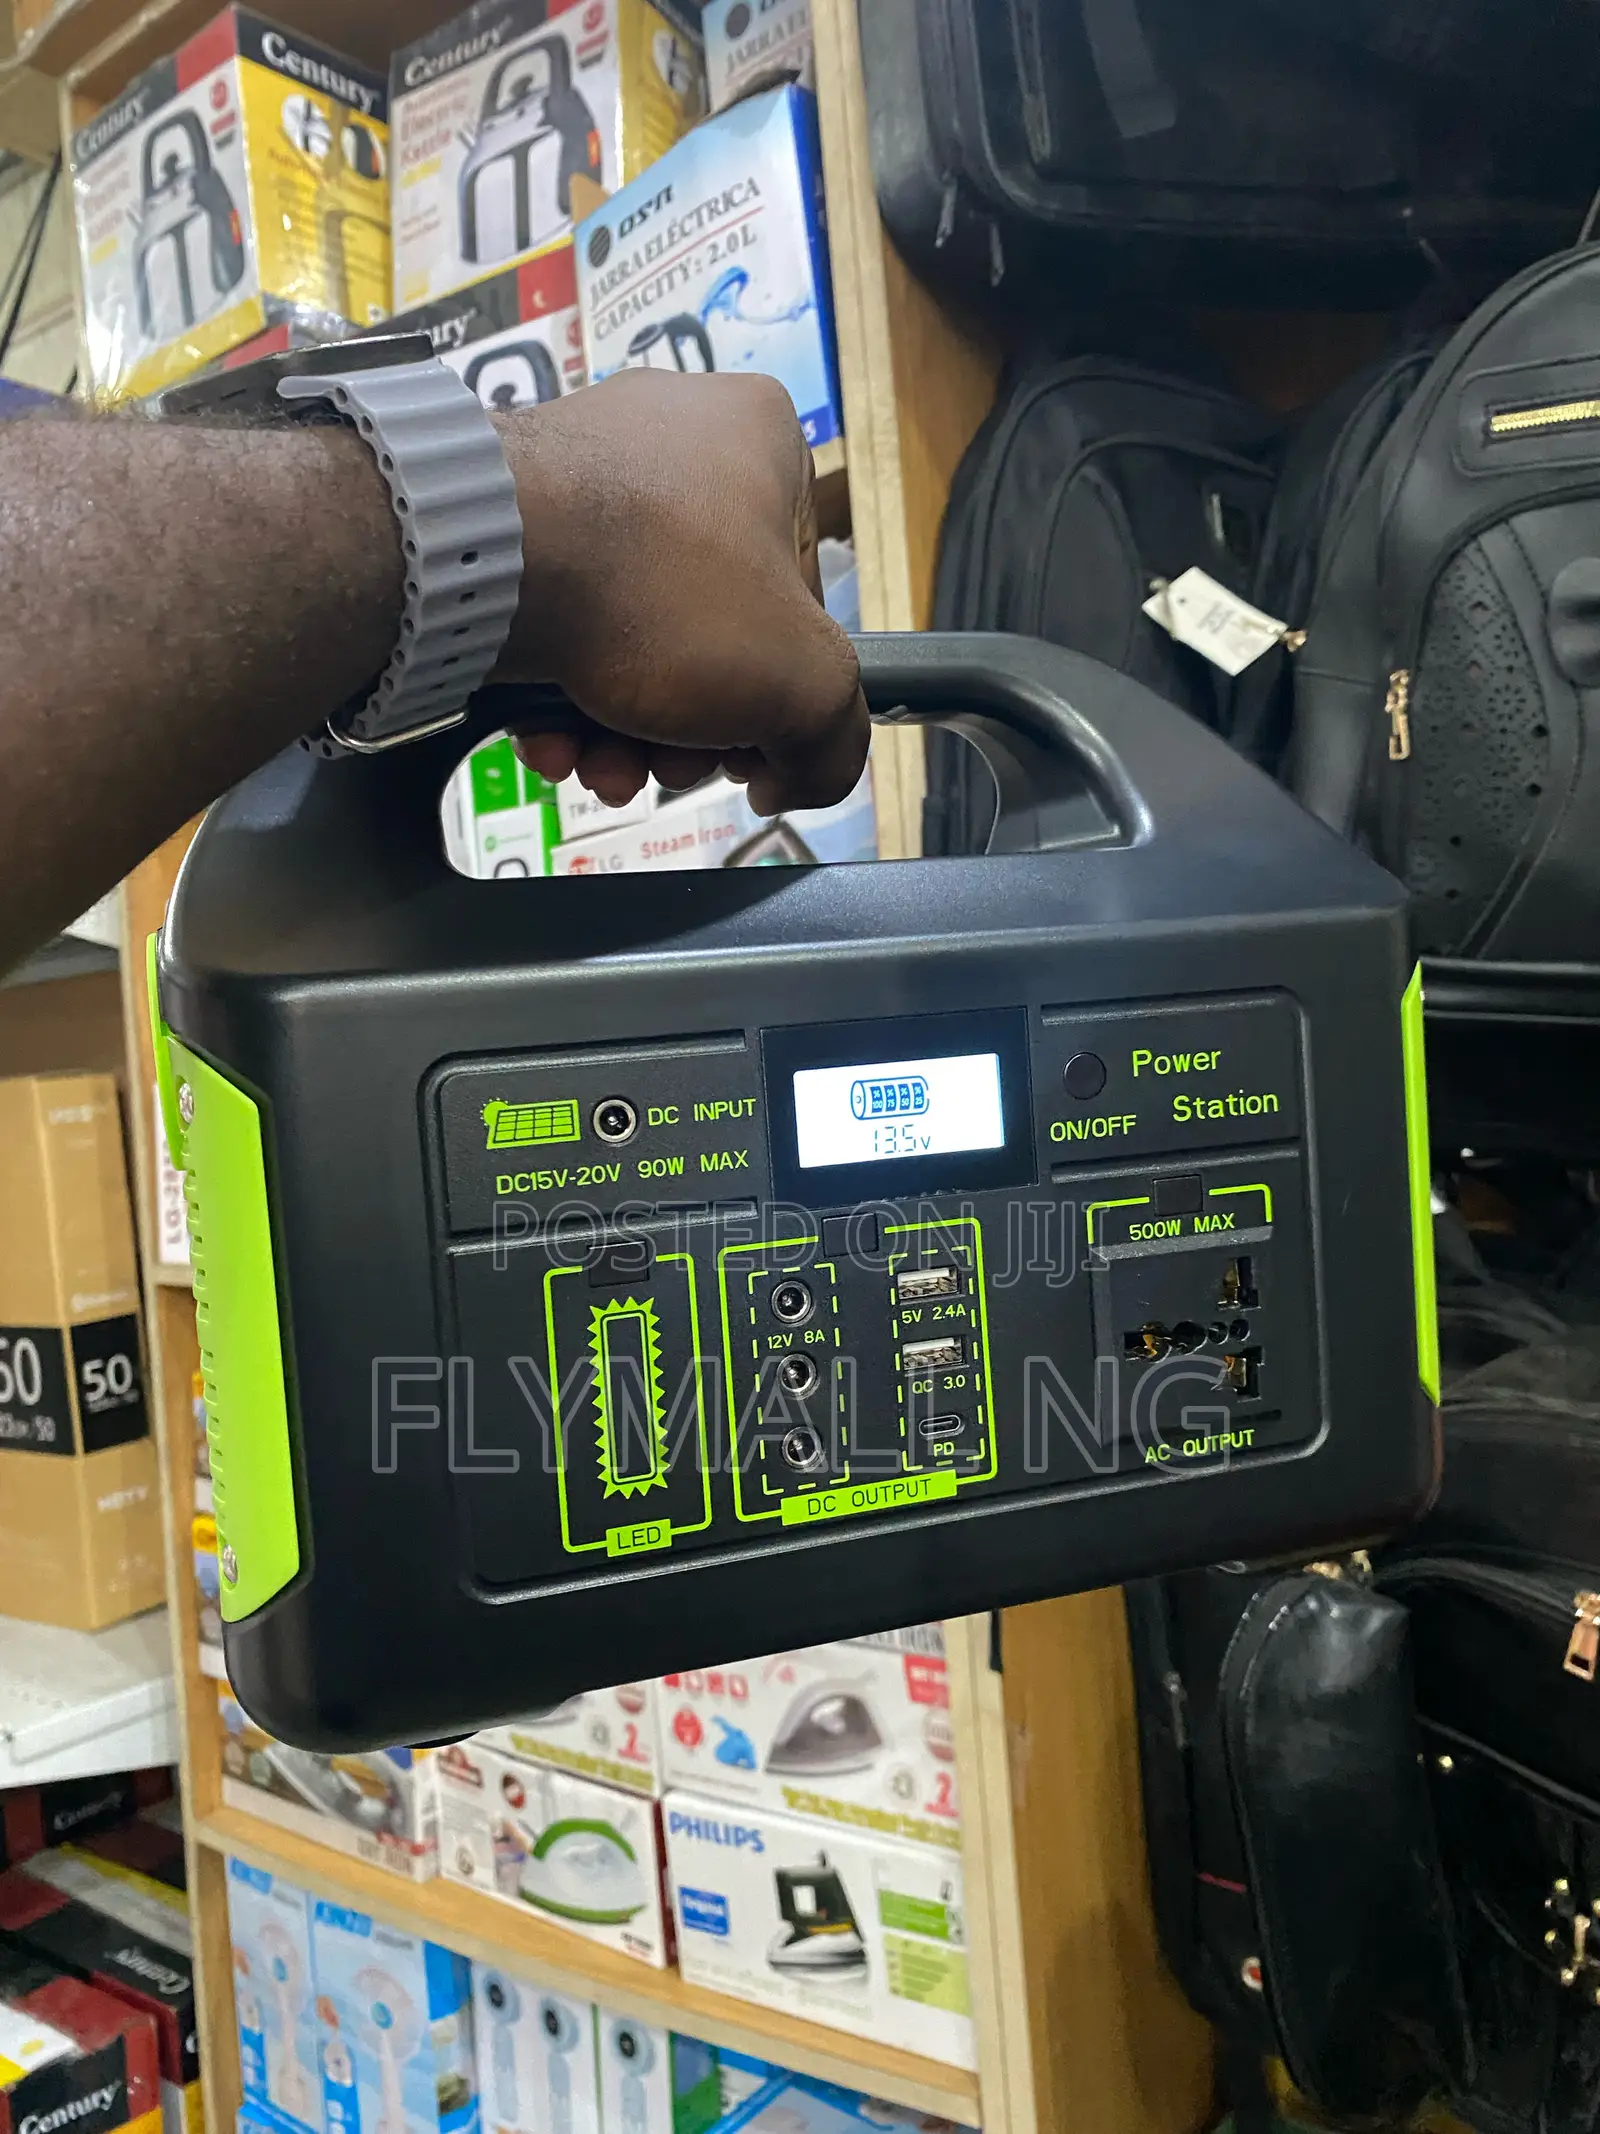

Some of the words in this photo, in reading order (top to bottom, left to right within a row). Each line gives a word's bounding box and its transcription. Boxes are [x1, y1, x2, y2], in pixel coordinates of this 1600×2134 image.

[262, 31, 380, 116] Century
[404, 29, 503, 88] Century
[76, 87, 148, 161] Century
[594, 255, 704, 341] CAPACITY:
[641, 832, 696, 859] Steam
[1132, 1049, 1222, 1077] Power
[648, 1106, 680, 1126] DC
[693, 1098, 757, 1122] INPUT
[1172, 1089, 1279, 1122] Station
[1050, 1114, 1137, 1142] ON/OFF
[496, 1163, 621, 1195] DC15V-20V
[637, 1156, 685, 1179] 90W
[699, 1149, 750, 1173] MAX
[1129, 1219, 1181, 1242] 500W
[1194, 1213, 1235, 1234] MAX
[901, 1309, 922, 1325] 5V
[932, 1303, 967, 1322] 2.4A
[767, 1332, 794, 1350] 12V
[803, 1329, 826, 1345] 8A
[82, 1353, 133, 1402] 50
[912, 1378, 933, 1395] QC
[943, 1374, 967, 1391] 3.0
[933, 1441, 955, 1457] PD
[1145, 1444, 1171, 1464] AC
[1182, 1429, 1255, 1459] OUTPUT
[807, 1496, 837, 1517] DC
[851, 1478, 932, 1508] OUTPUT
[616, 1526, 661, 1550] LED
[668, 1811, 766, 1853] PHILIPS
[18, 2079, 123, 2134] Century
